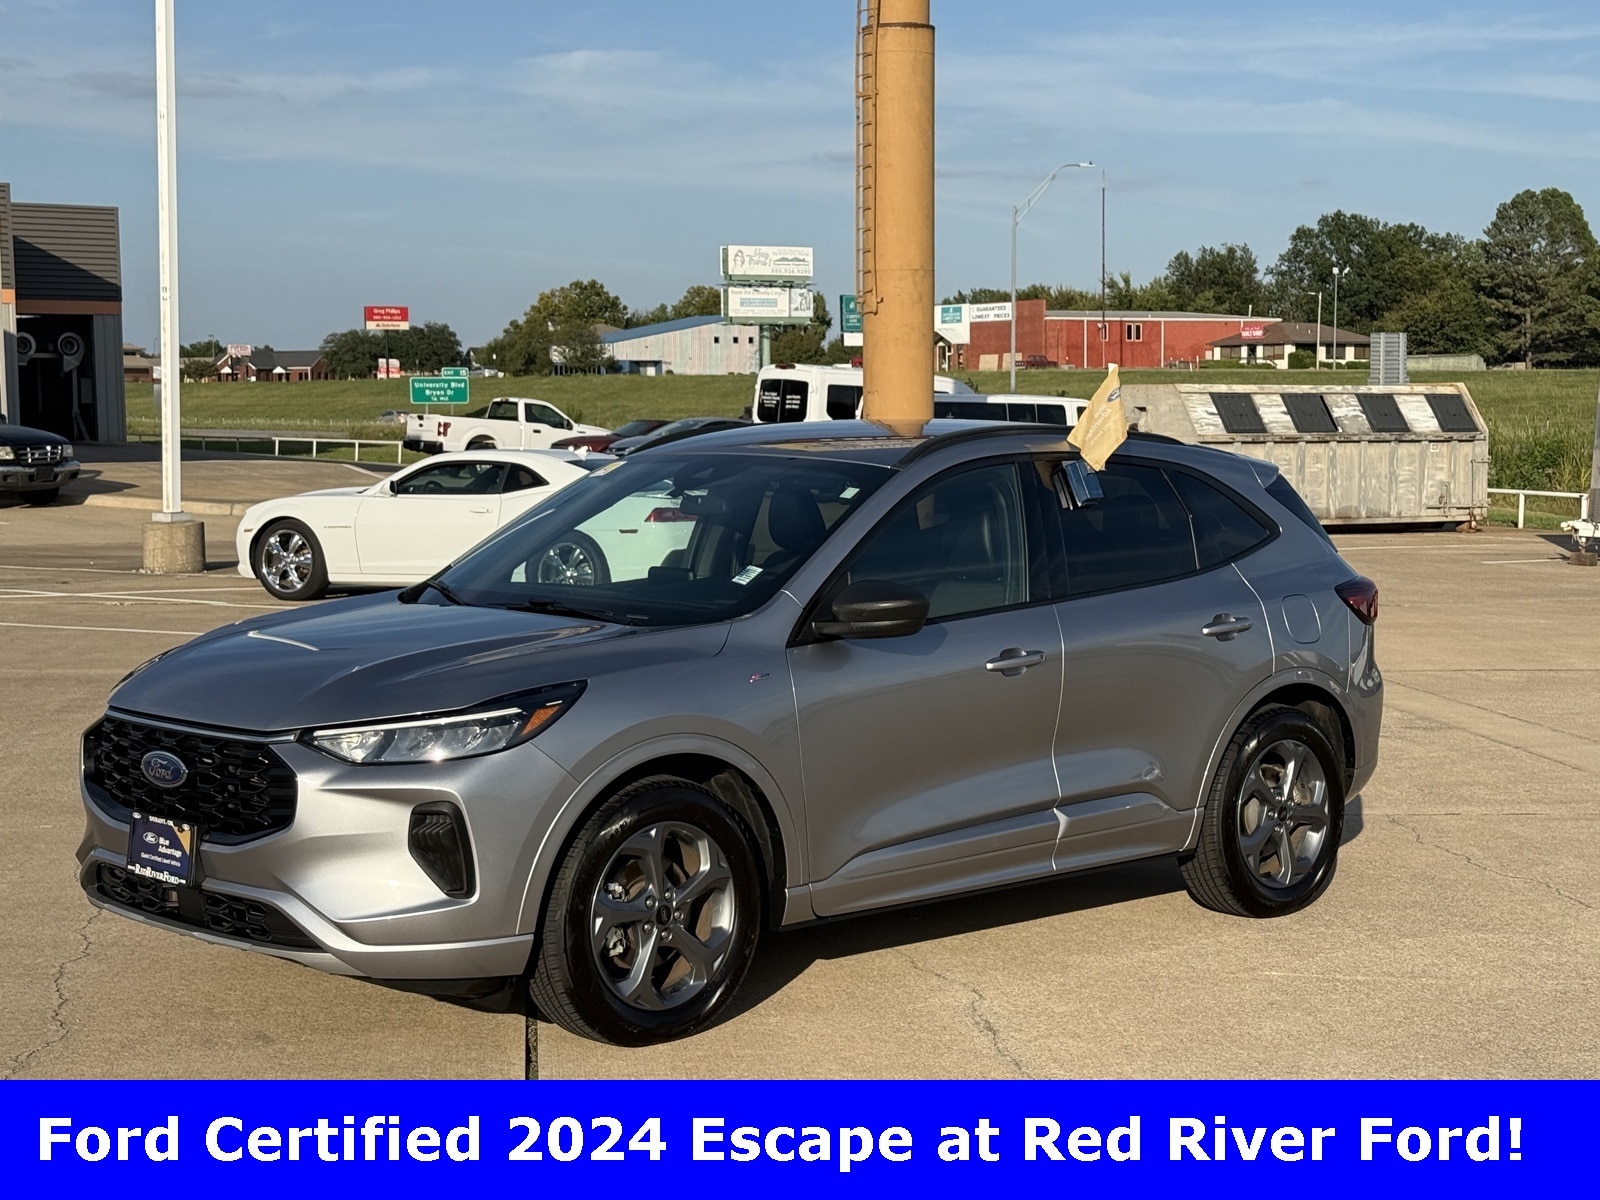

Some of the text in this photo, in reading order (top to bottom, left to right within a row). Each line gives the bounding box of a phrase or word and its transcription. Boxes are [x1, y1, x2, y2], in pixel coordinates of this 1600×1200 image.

[414, 381, 465, 389] University Blvd
[425, 389, 445, 397] Bryan
[148, 757, 174, 780] Ford
[159, 837, 170, 846] Blue
[158, 845, 182, 858] Advantage
